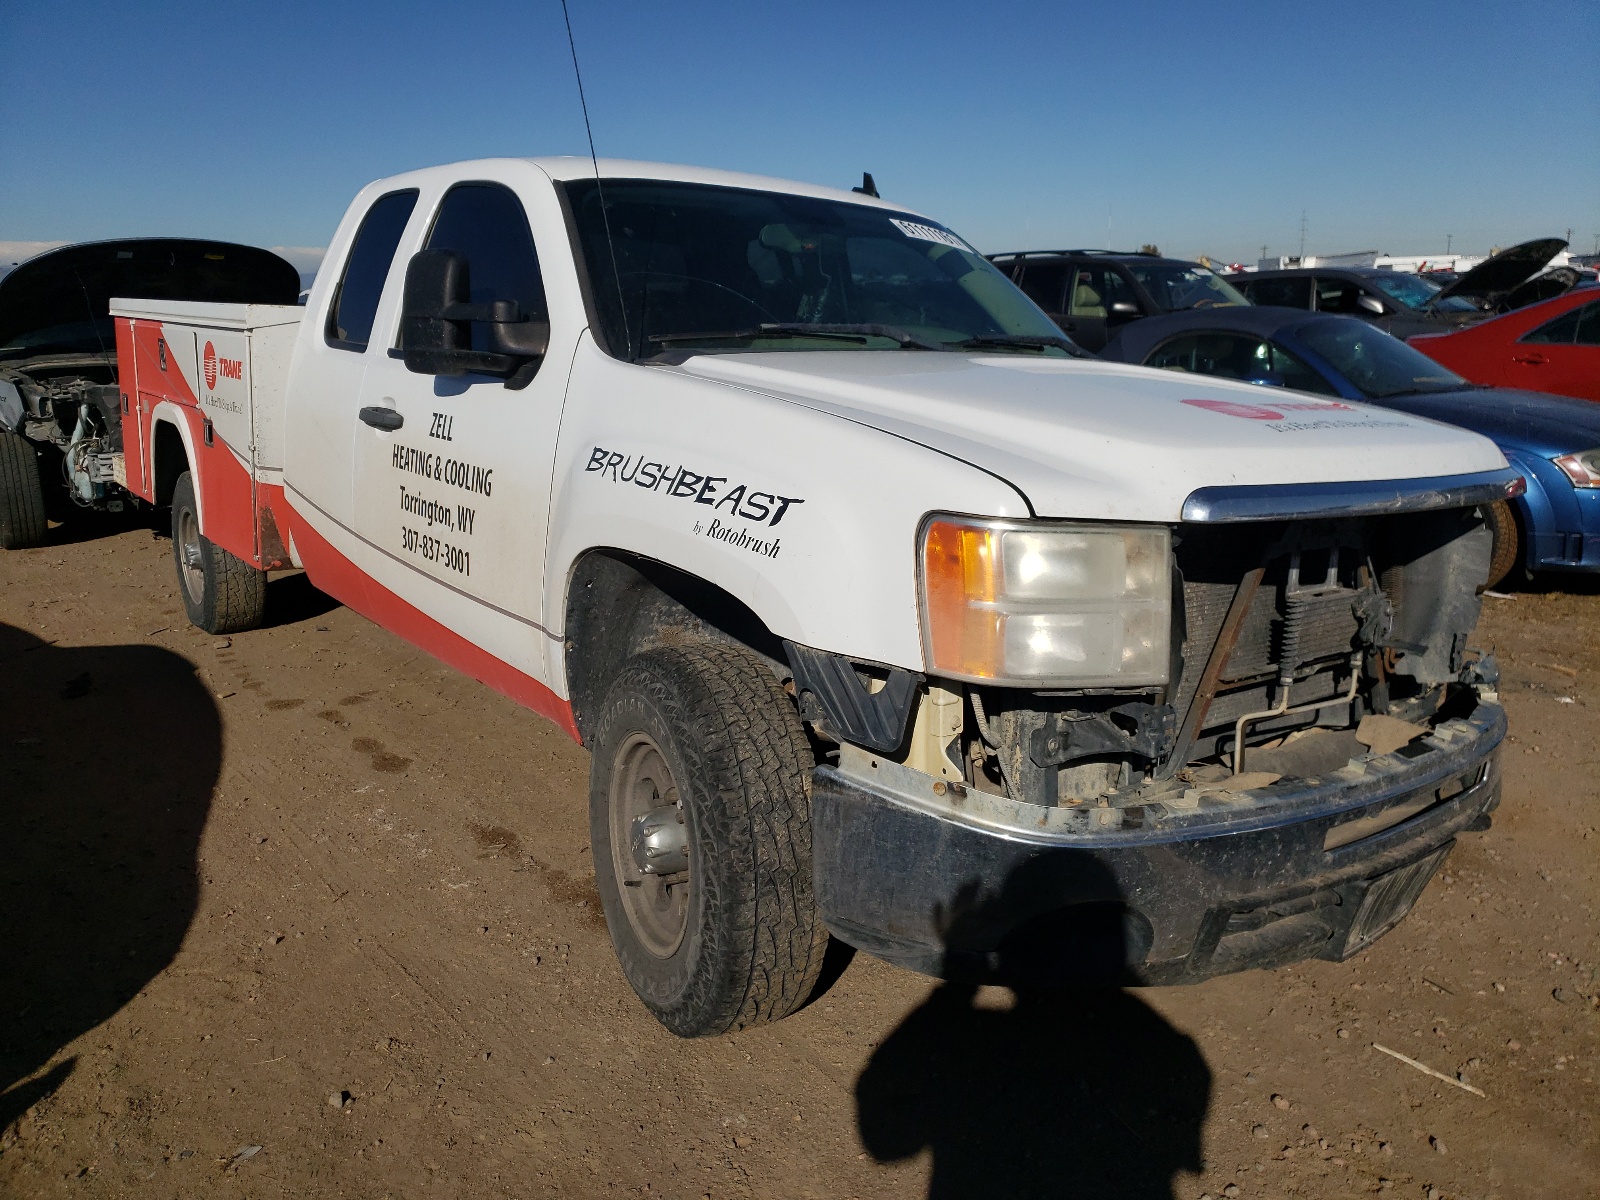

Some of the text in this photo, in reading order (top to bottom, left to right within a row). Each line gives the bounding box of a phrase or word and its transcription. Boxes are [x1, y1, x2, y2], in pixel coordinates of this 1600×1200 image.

[219, 357, 242, 380] TRANE
[429, 412, 453, 441] ZELL
[392, 444, 493, 497] HEATING & COOLING
[585, 446, 805, 527] BRUSHBEAST
[400, 485, 475, 535] Torrington, WY
[402, 526, 470, 576] 307-837-3001
[692, 518, 781, 559] by Rotobrush
